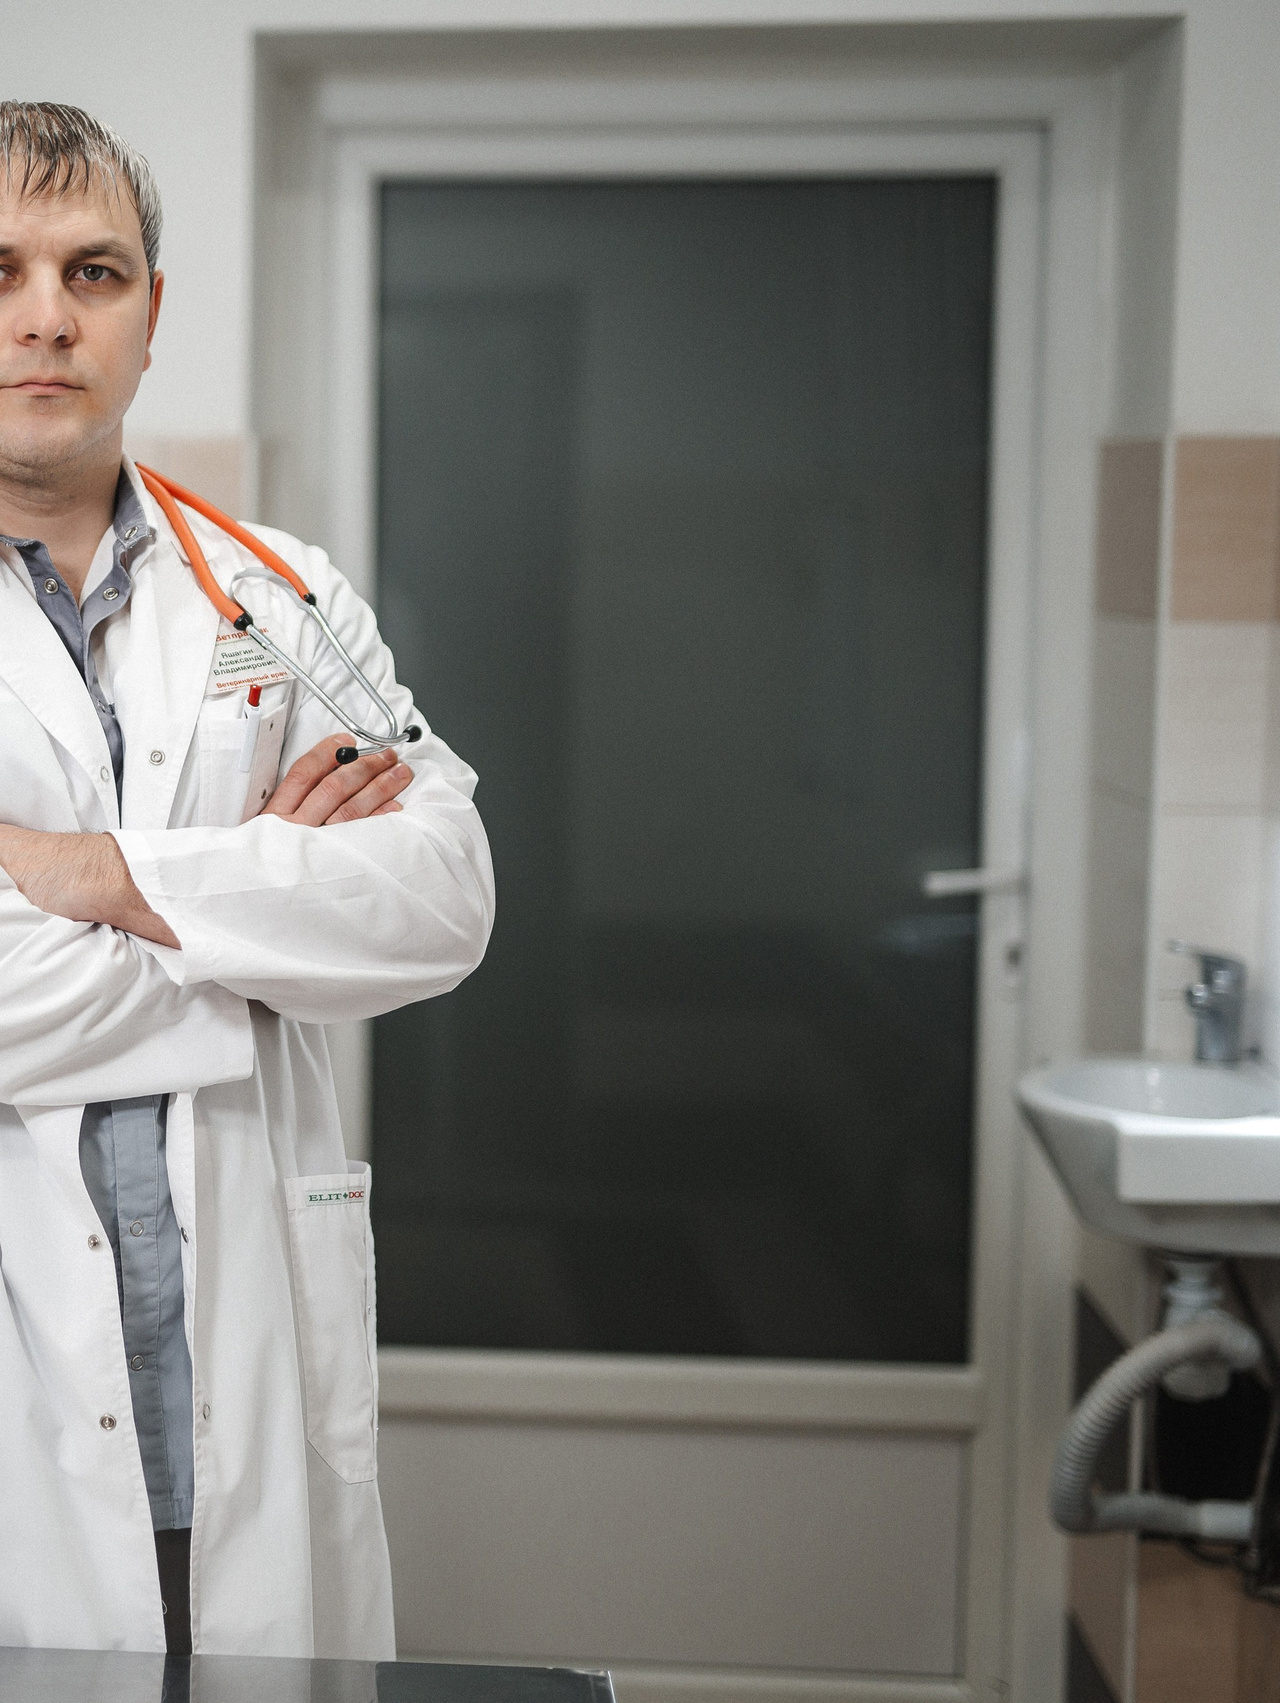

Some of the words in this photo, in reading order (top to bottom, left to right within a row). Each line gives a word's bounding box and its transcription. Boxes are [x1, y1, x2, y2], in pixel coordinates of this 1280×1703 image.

[221, 648, 254, 659] Яшагин
[218, 654, 265, 667] Александр
[213, 660, 277, 676] Владимирович
[216, 673, 269, 689] Ветеринарный
[270, 671, 288, 679] врач
[308, 1193, 342, 1202] ELIT
